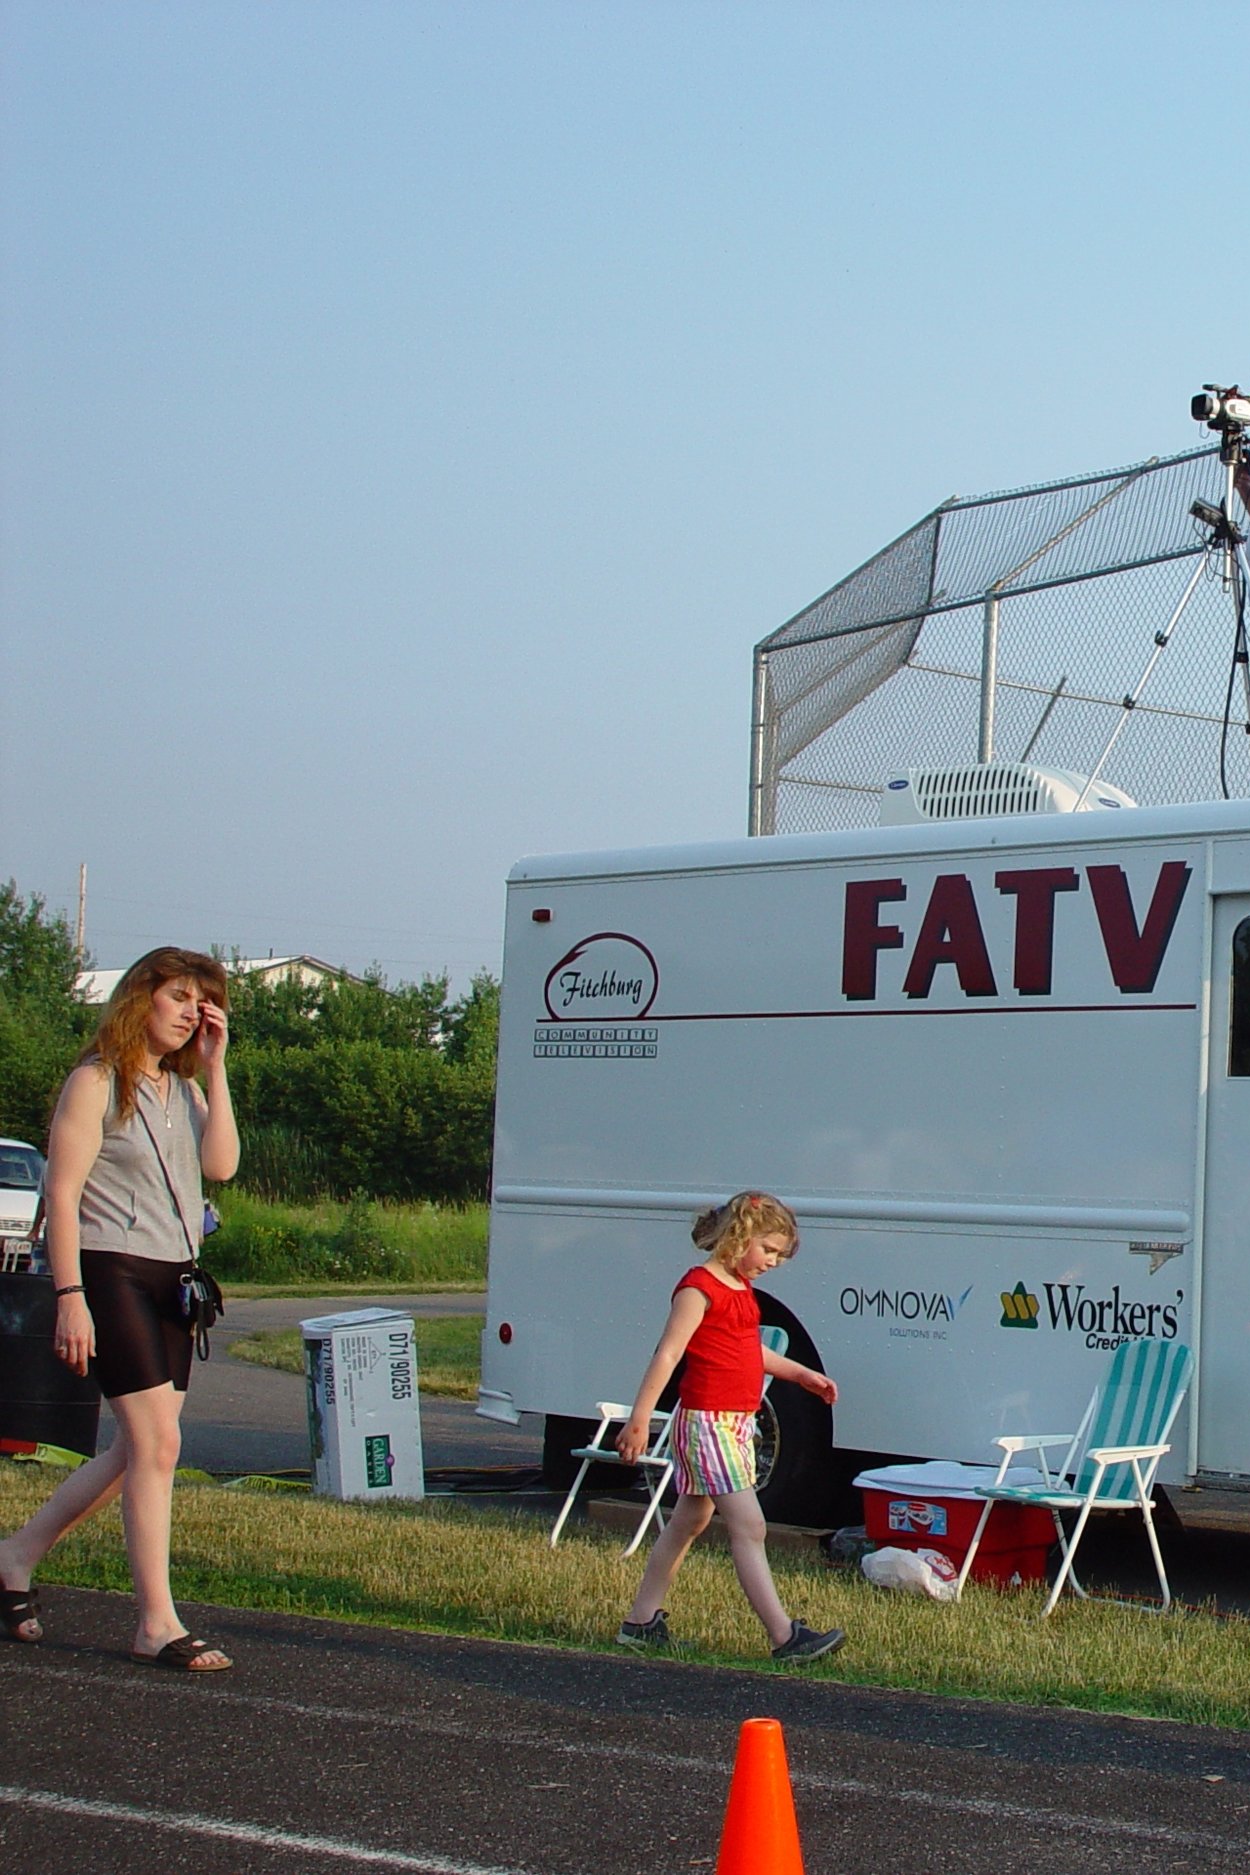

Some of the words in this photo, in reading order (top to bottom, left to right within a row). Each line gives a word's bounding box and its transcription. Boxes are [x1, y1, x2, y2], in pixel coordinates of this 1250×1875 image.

[841, 860, 1194, 1001] FATV
[559, 969, 643, 1007] Fitchburg
[535, 1045, 656, 1057] TELEVISION
[536, 1029, 657, 1041] COMMUNITY
[840, 1286, 951, 1322] OMNOVA
[1043, 1282, 1184, 1340] Workers'
[388, 1333, 411, 1399] D71/90255
[373, 1438, 387, 1484] GARDEN
